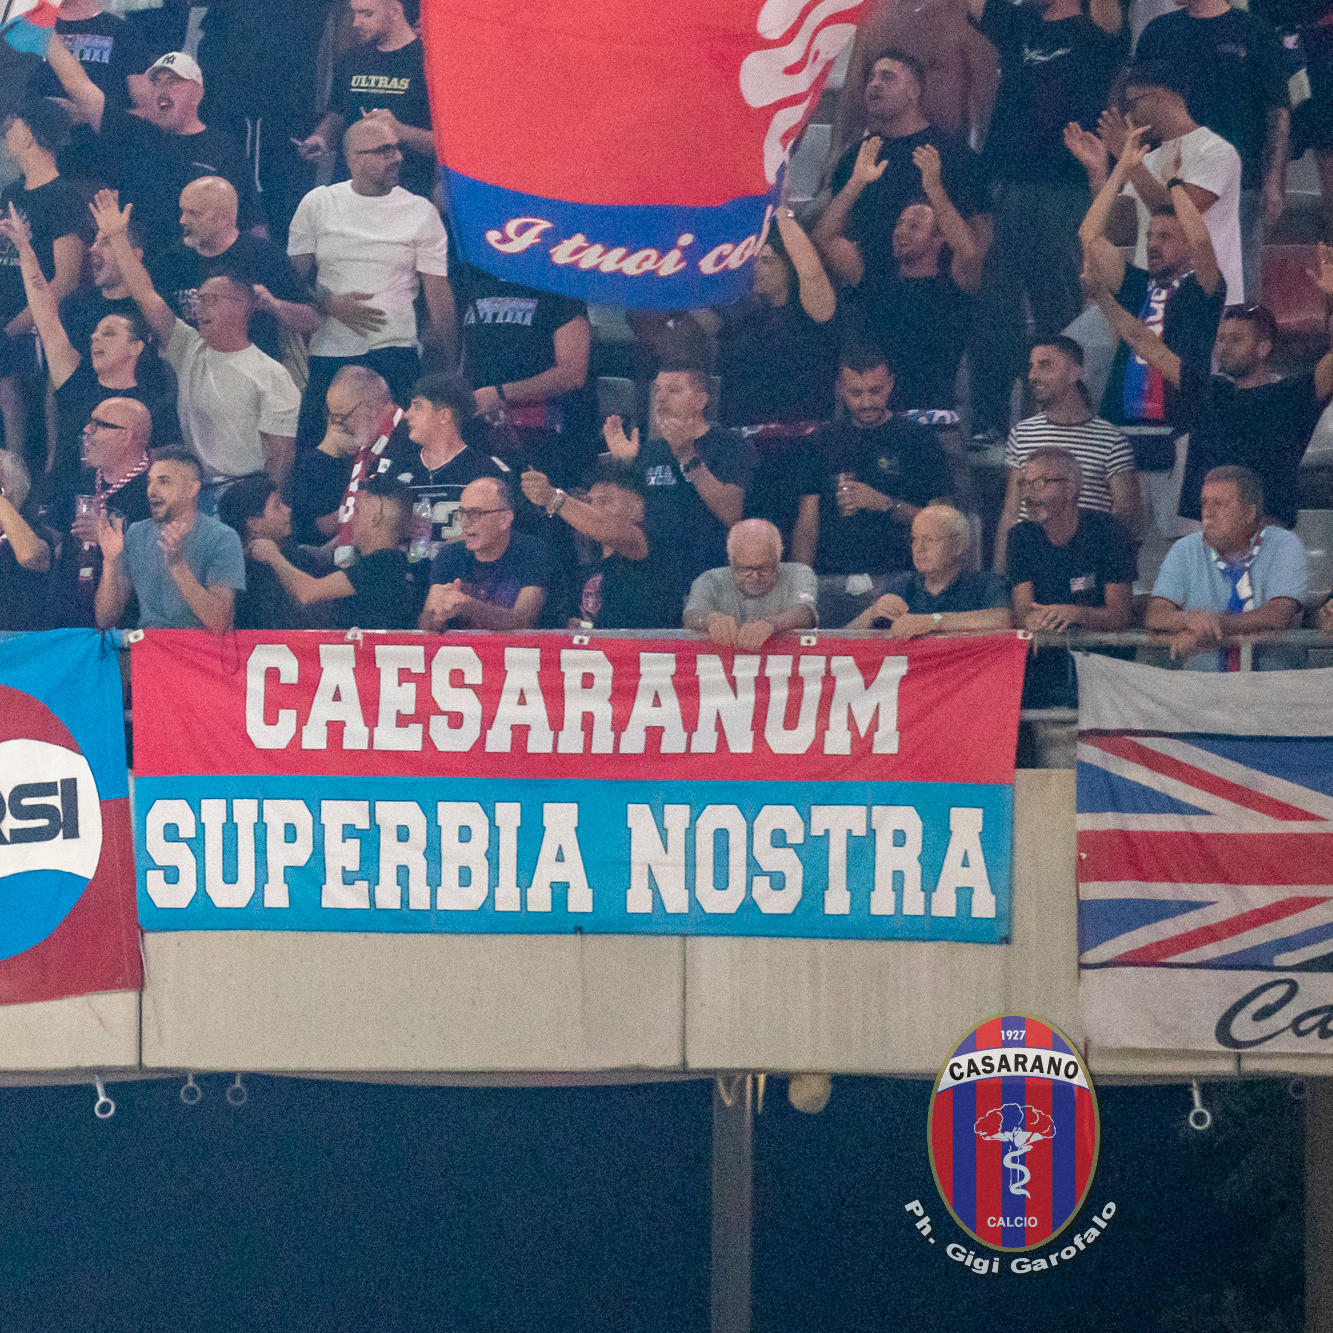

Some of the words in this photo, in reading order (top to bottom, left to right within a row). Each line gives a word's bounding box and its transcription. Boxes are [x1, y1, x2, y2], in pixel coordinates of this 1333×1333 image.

[350, 74, 411, 90] ULTRAS
[550, 232, 695, 276] tuoi
[244, 644, 909, 755] CAESARANUM
[144, 798, 594, 914] SUPERBIA
[625, 802, 997, 919] NOSTRA
